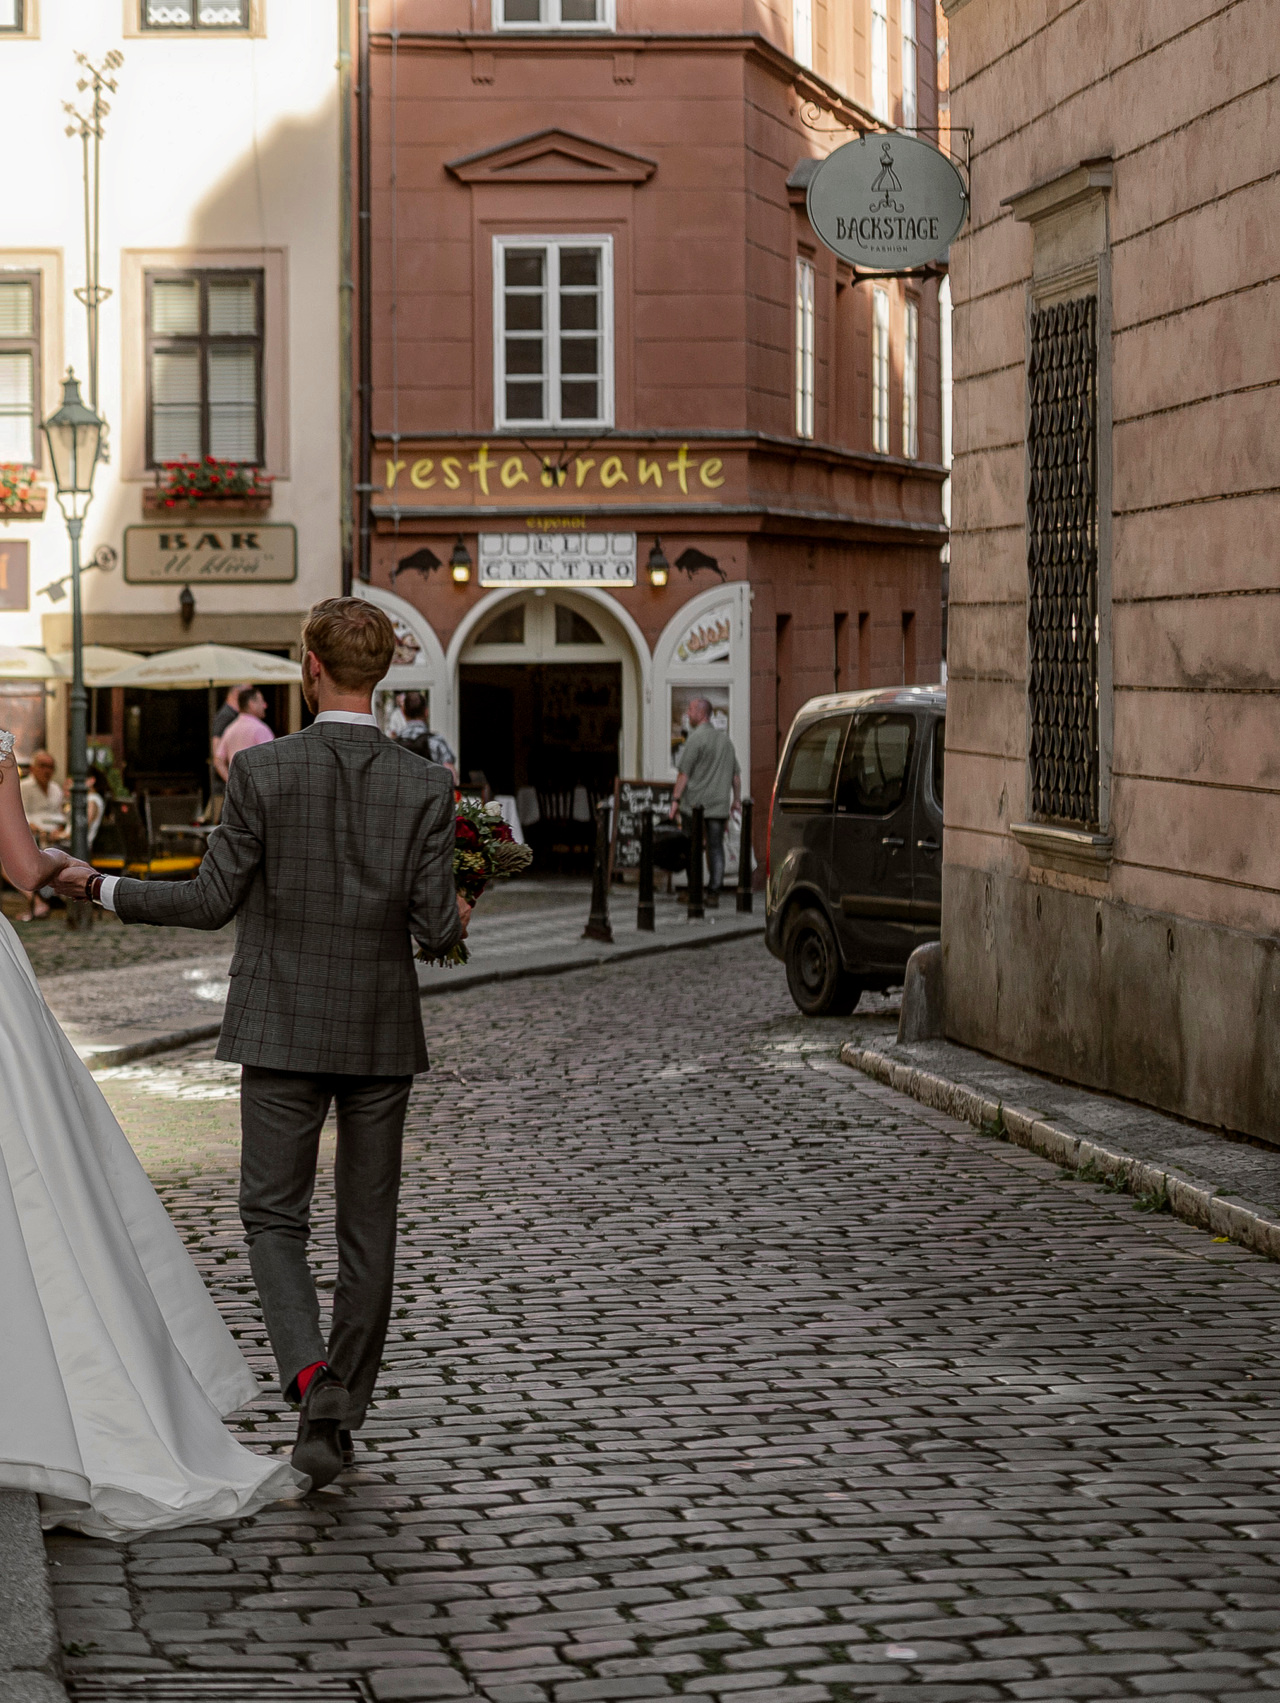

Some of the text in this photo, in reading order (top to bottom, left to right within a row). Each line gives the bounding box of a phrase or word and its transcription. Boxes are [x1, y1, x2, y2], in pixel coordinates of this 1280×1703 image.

[836, 216, 939, 249] BACKSTAGE
[385, 442, 725, 495] restaurante
[159, 533, 261, 550] BAR
[536, 536, 580, 551] EL
[485, 563, 630, 579] CENTRO
